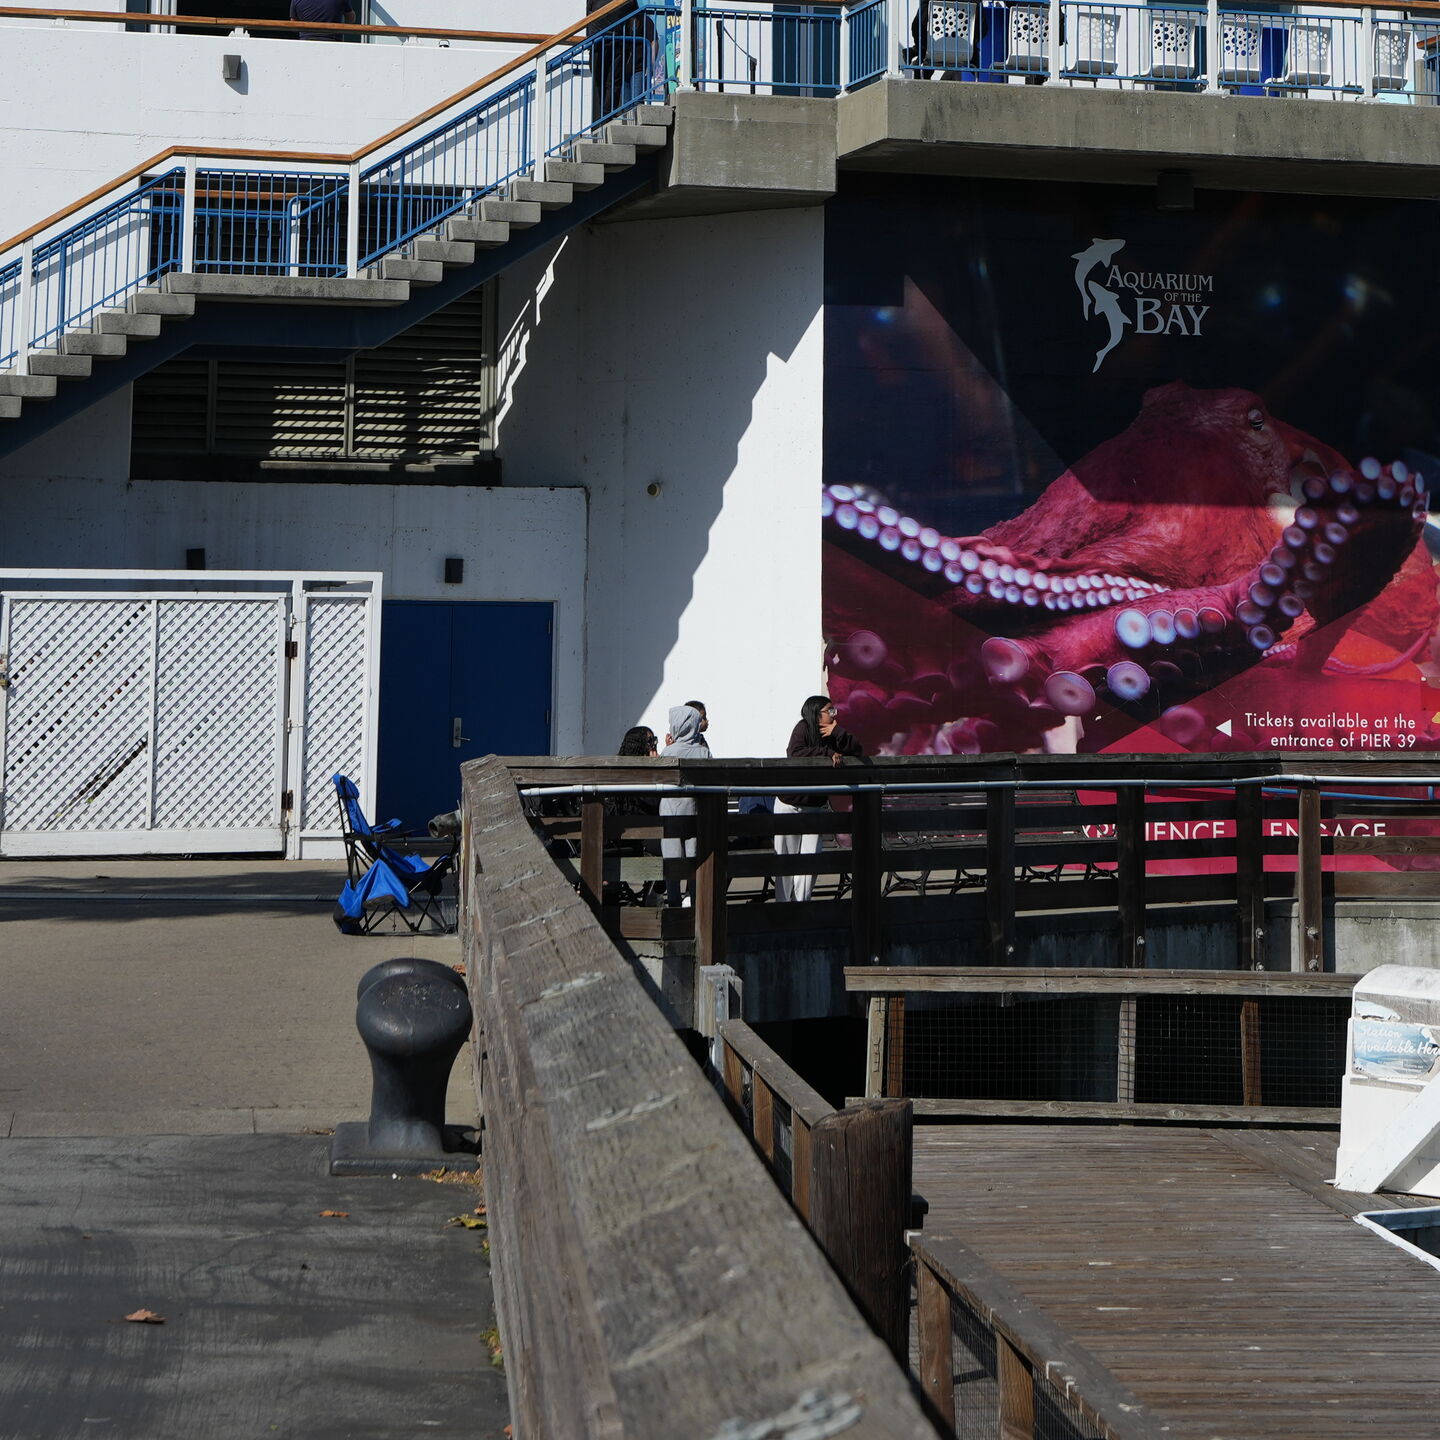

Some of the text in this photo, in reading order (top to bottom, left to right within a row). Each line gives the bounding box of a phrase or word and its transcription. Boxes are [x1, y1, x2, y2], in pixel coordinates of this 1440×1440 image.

[1105, 265, 1213, 295] AQUARIUM
[1164, 292, 1202, 303] OF THE
[1134, 297, 1210, 336] BAY
[1245, 712, 1416, 729] Tickets available at the
[1271, 732, 1417, 748] entrance of PIER 39
[1359, 1040, 1416, 1057] Available
